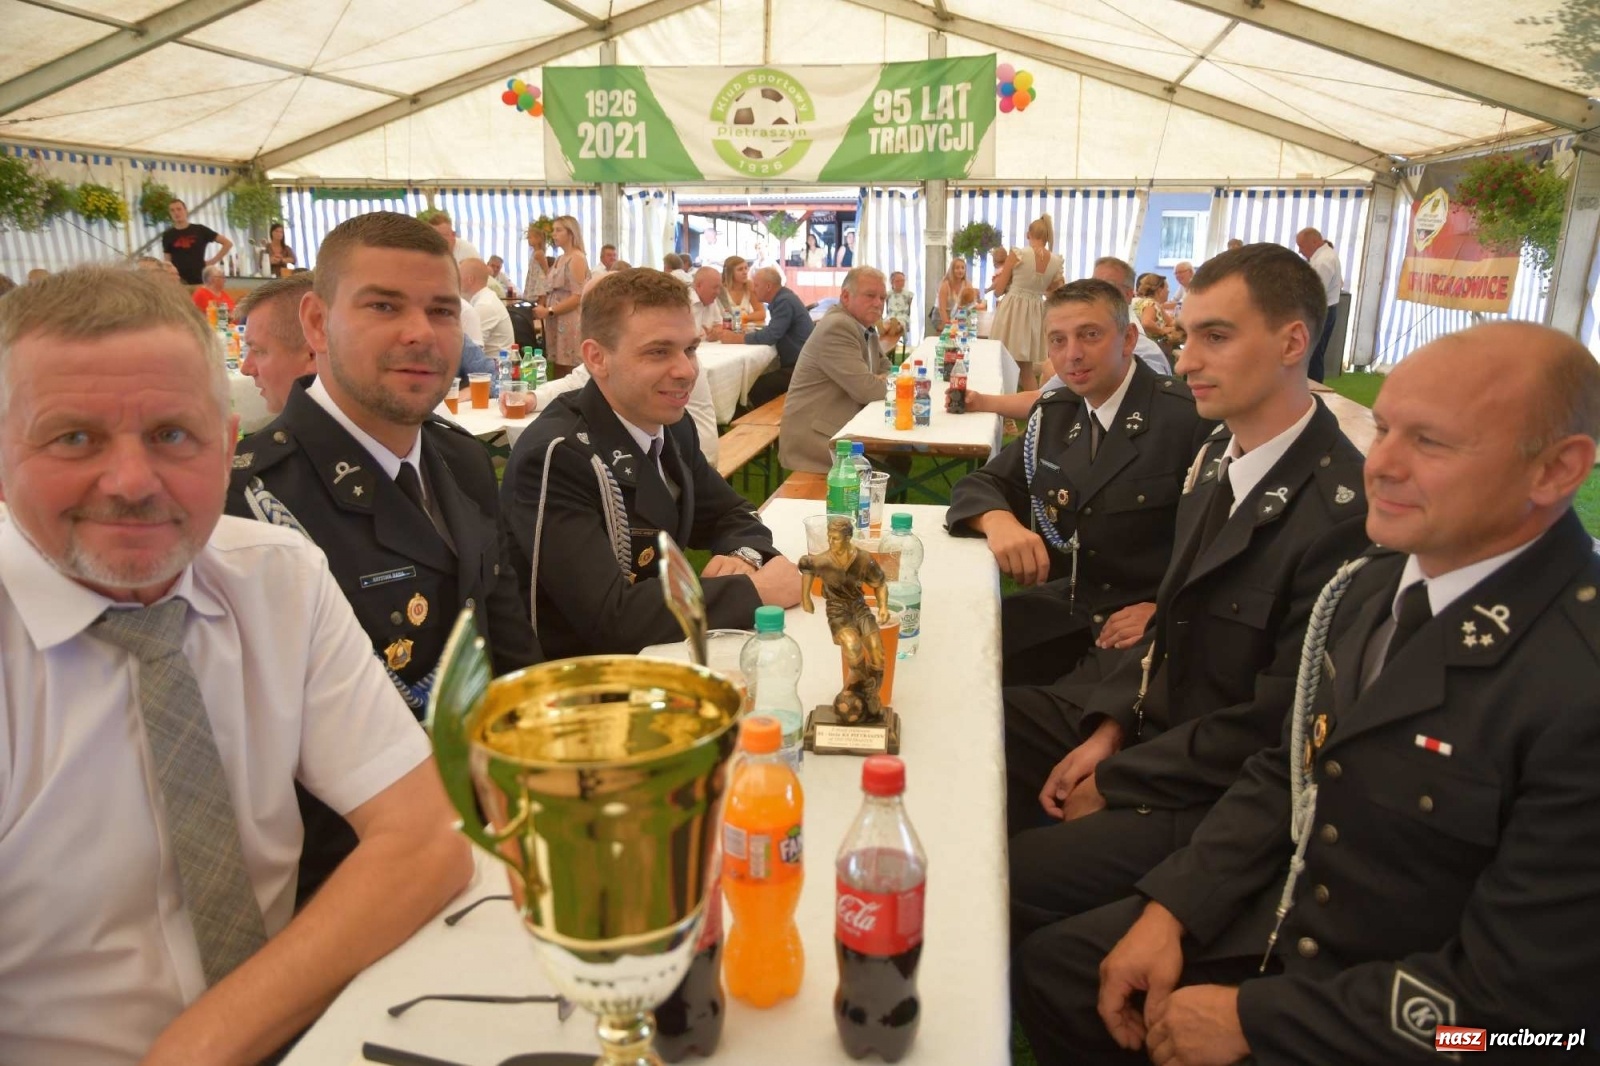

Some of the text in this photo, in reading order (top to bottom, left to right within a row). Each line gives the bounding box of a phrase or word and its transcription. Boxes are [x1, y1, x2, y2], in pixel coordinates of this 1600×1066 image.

[585, 89, 637, 117] 1926
[716, 73, 808, 113] Klub Sportowy
[873, 82, 972, 124] 95 LAT
[577, 121, 647, 159] 2021
[717, 126, 807, 138] Pietraszyn
[868, 121, 975, 155] TRADYCJI
[739, 160, 783, 173] 1926
[1410, 1006, 1435, 1028] K
